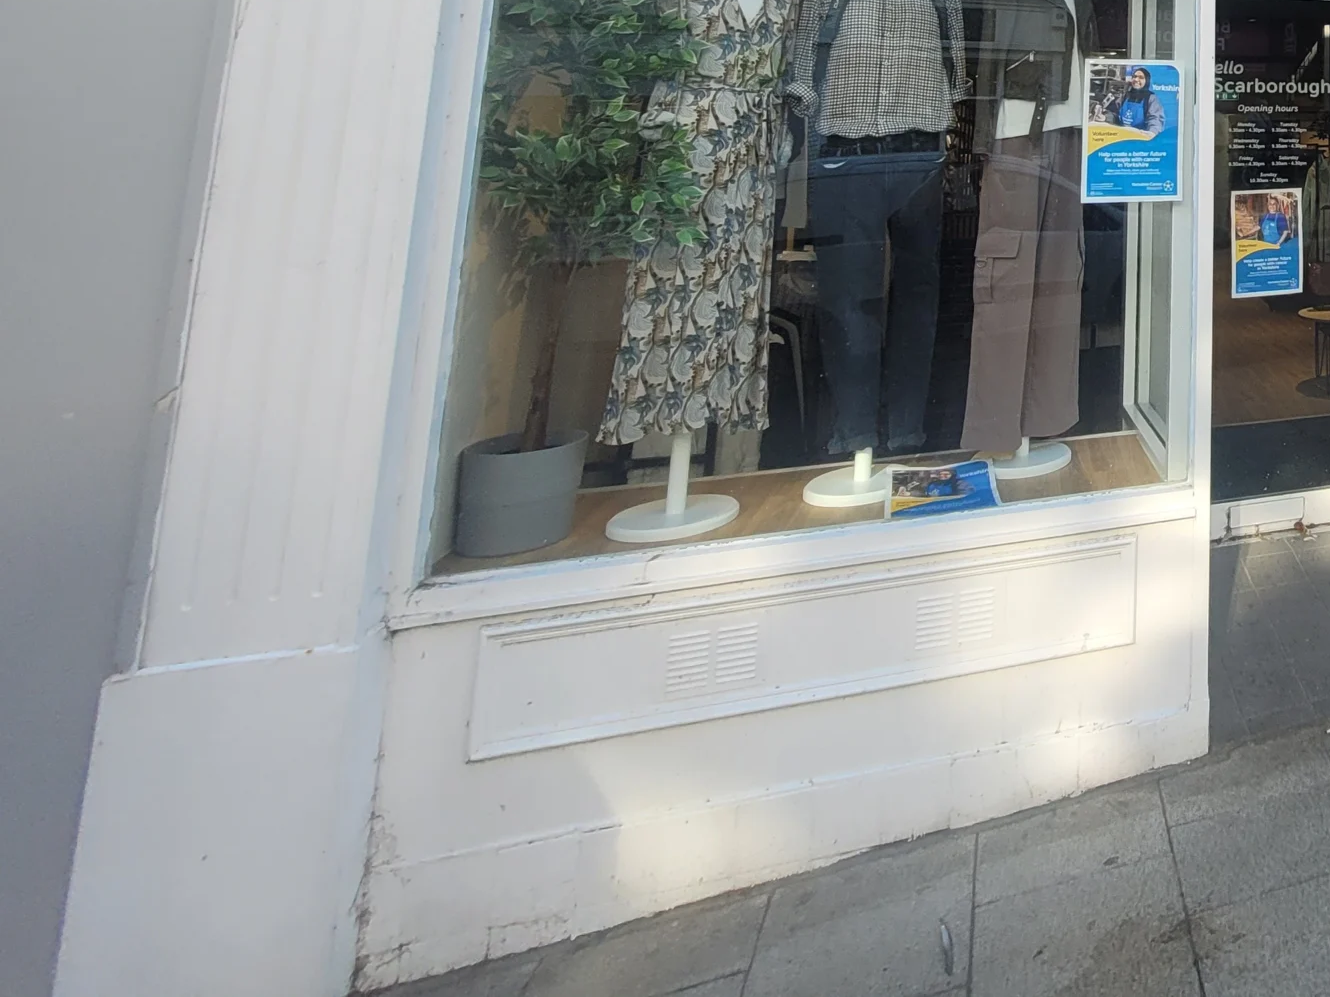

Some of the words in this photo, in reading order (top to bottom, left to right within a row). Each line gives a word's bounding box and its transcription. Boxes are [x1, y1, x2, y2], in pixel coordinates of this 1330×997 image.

[1215, 60, 1244, 74] ello
[1237, 104, 1273, 114] Opening
[1275, 104, 1299, 112] hours
